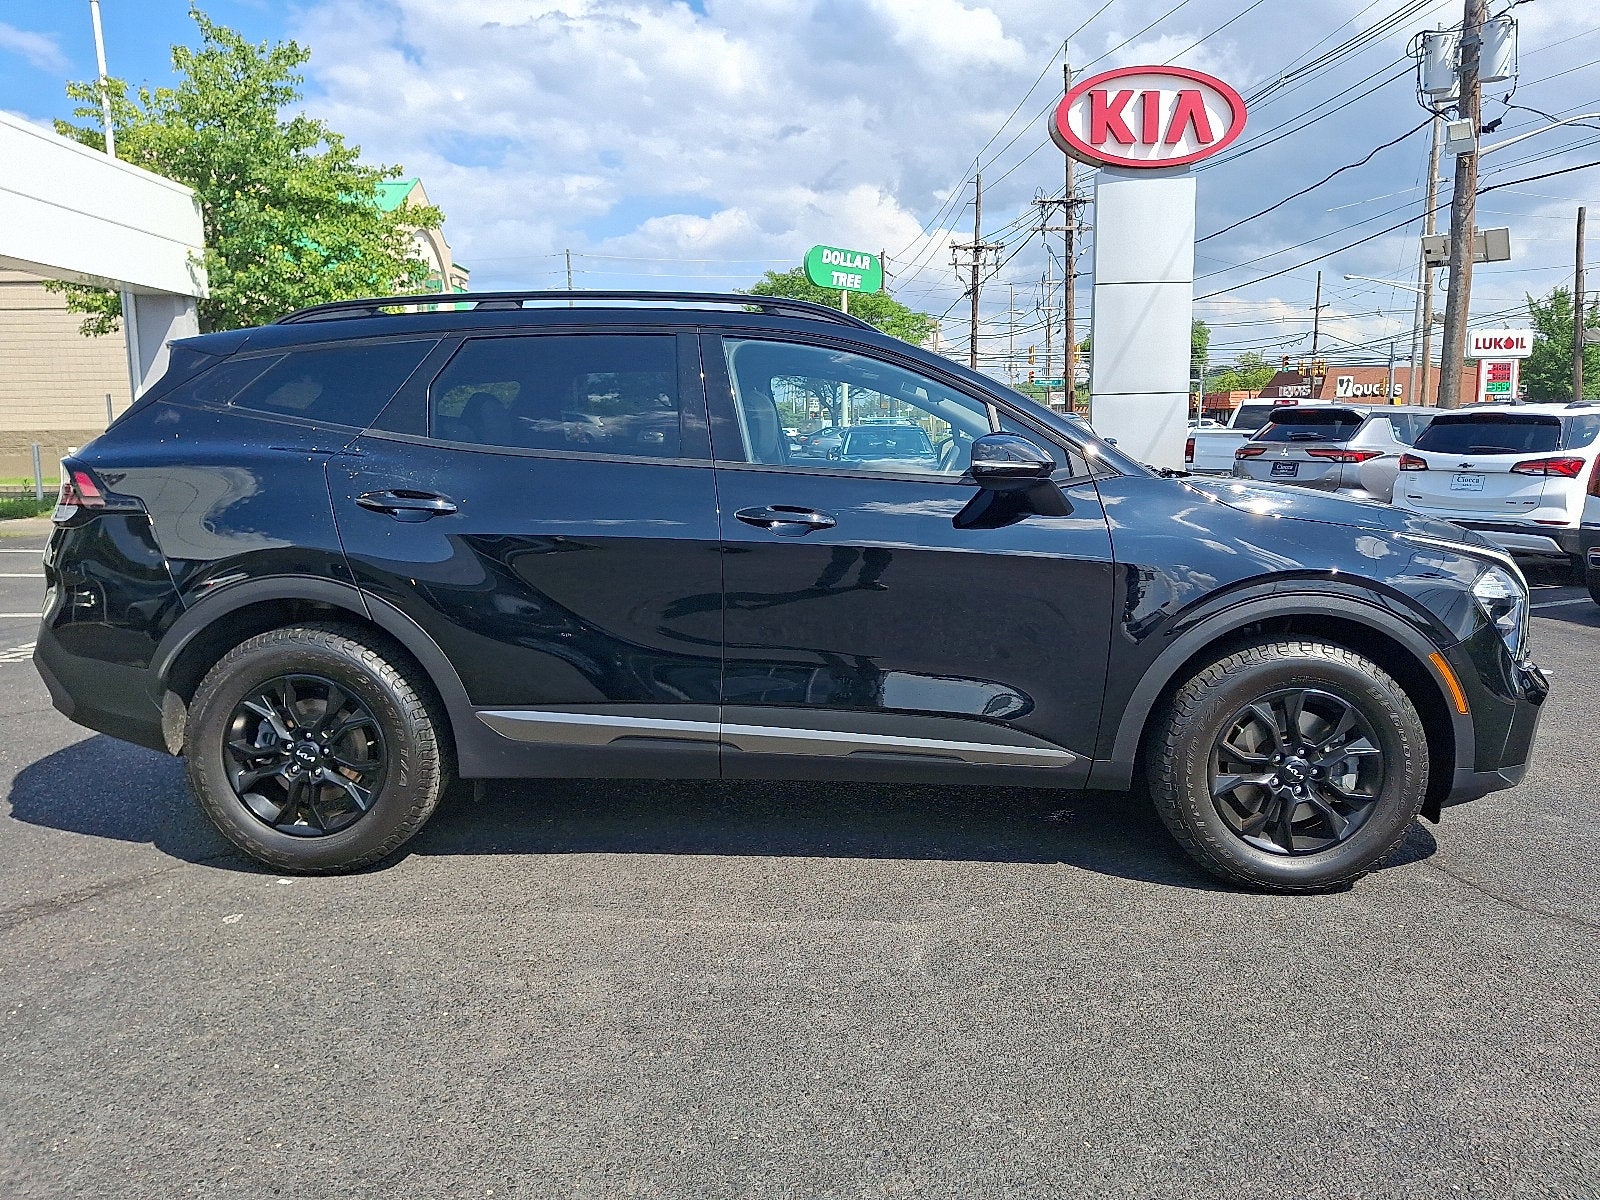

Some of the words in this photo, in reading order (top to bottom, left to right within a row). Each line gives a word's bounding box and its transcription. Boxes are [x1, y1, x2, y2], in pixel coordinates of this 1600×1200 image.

[1089, 90, 1214, 145] KIA
[822, 249, 871, 270] DOLLAR
[831, 271, 862, 289] TREE
[1475, 336, 1527, 349] LUKOIL
[1352, 383, 1403, 396] QUOS
